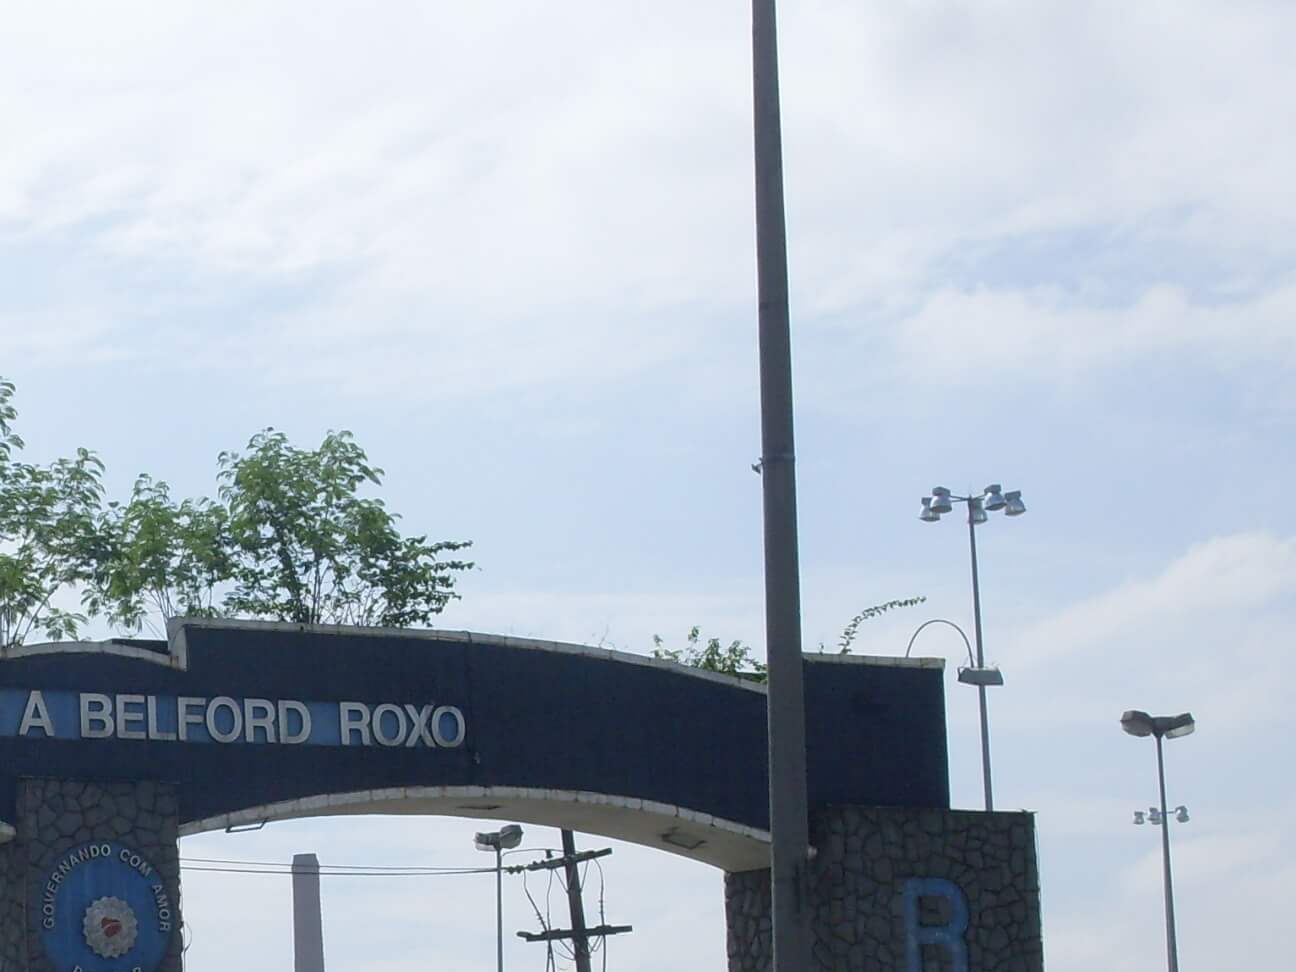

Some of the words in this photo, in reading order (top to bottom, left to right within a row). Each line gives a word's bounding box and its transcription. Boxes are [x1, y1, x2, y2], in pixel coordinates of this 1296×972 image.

[19, 690, 55, 738] A
[80, 693, 312, 744] BELFORD
[340, 701, 466, 747] ROXO
[42, 843, 112, 929] GOVERNANDO
[119, 848, 152, 877] COM
[151, 883, 172, 932] AMOR
